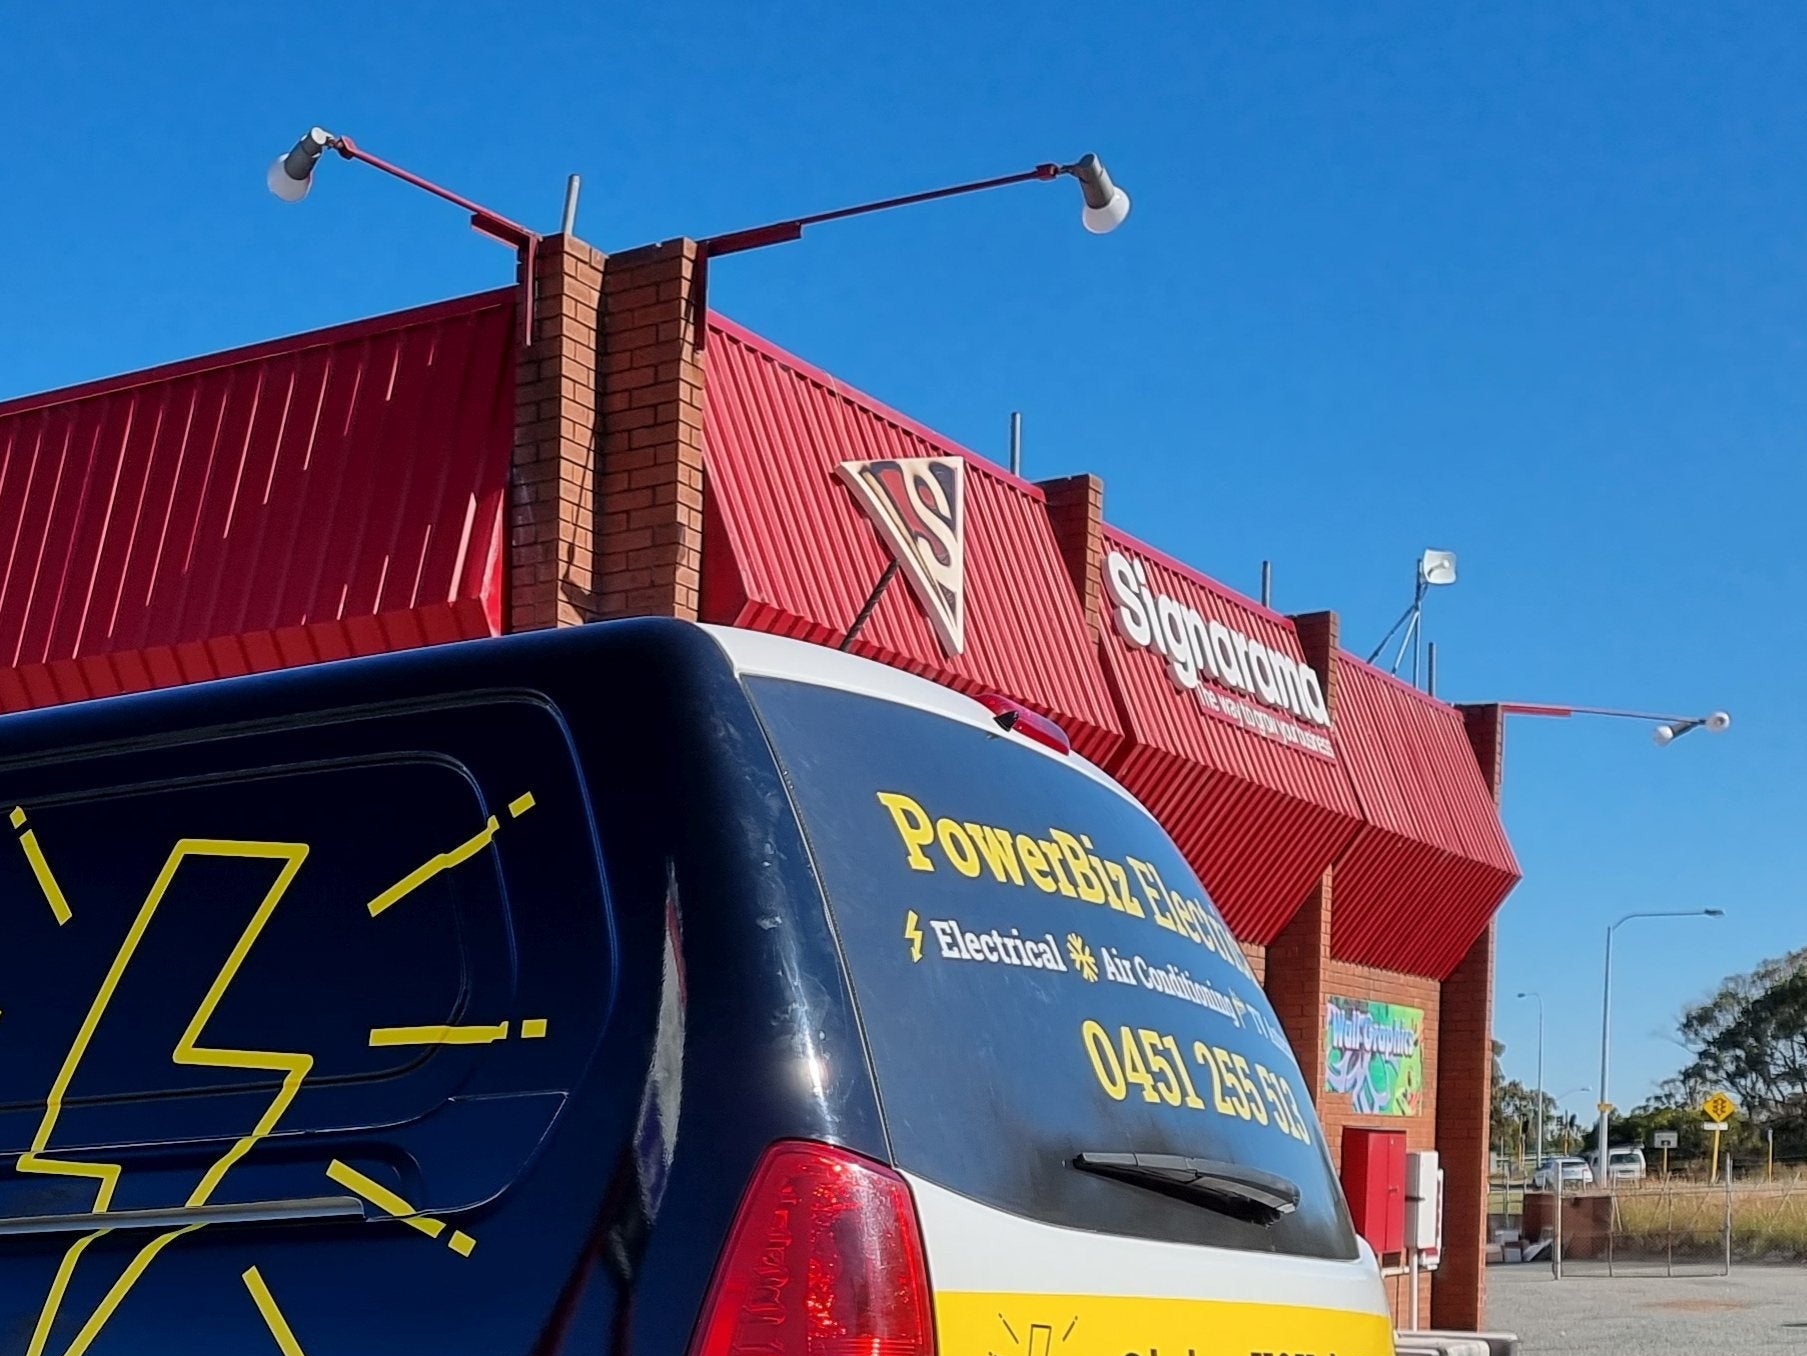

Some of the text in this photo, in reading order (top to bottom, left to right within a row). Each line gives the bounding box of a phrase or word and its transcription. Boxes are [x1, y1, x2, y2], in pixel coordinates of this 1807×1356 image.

[1104, 551, 1331, 728] Signarama
[877, 792, 1145, 918] PowerBiz
[929, 920, 1067, 972] Electrical
[1100, 947, 1137, 986] Air
[1134, 955, 1240, 1028] Conditioning
[1082, 1019, 1205, 1109] 0451
[1193, 1040, 1269, 1126] 255
[1255, 1063, 1311, 1145] 513
